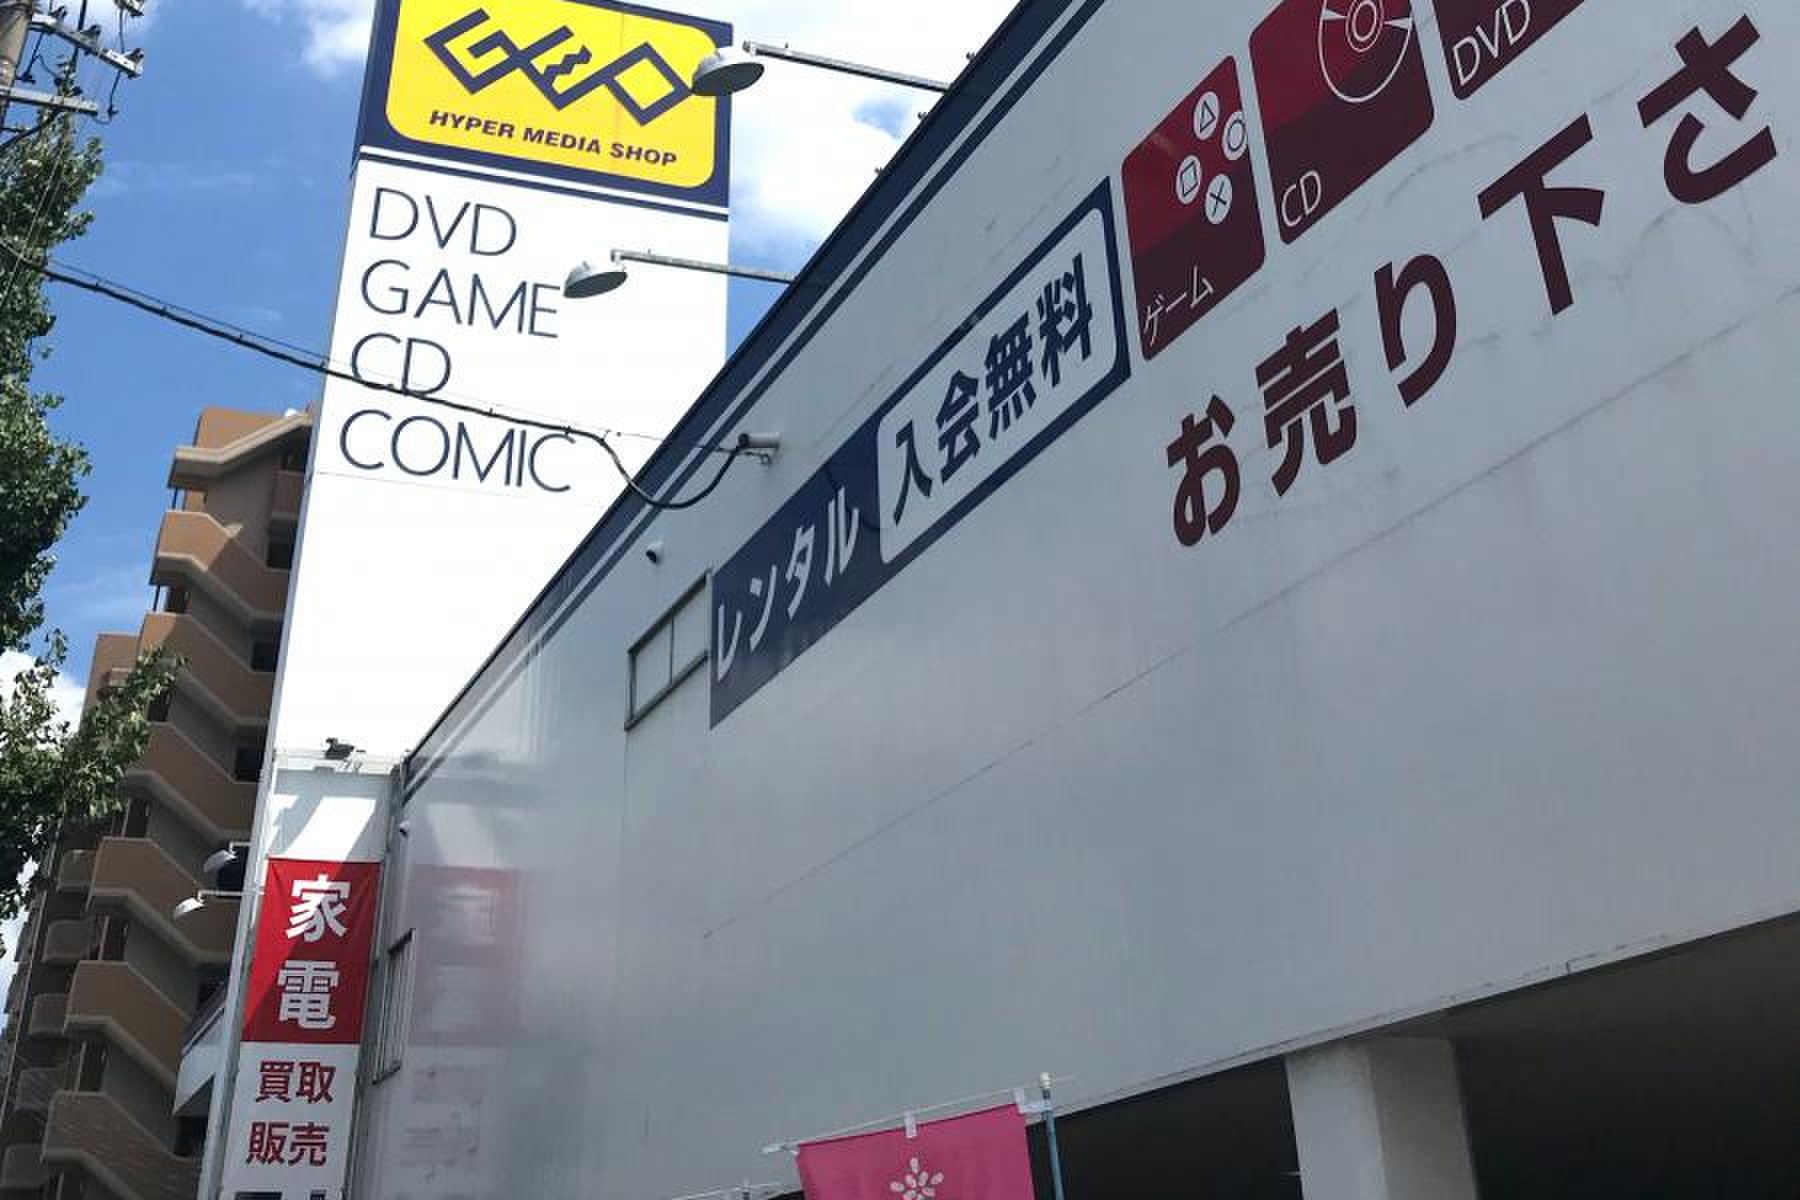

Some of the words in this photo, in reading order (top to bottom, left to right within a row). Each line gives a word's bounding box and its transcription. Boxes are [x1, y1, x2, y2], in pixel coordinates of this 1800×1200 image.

[429, 109, 515, 140] HYPER
[523, 127, 602, 155] MEDIA
[610, 142, 678, 167] SHOP
[369, 187, 517, 257] DVD
[1281, 170, 1322, 227] CD
[361, 259, 561, 339] GAME
[1144, 265, 1214, 346] ゲーム
[1166, 13, 1777, 547] お売り下さ
[351, 333, 452, 396] CD
[893, 252, 1093, 525] 入会無料
[340, 409, 576, 492] COMIC
[716, 486, 860, 682] レンタル
[276, 874, 350, 1030] 家電
[255, 1060, 336, 1104] 買取
[245, 1121, 330, 1167] 販売
